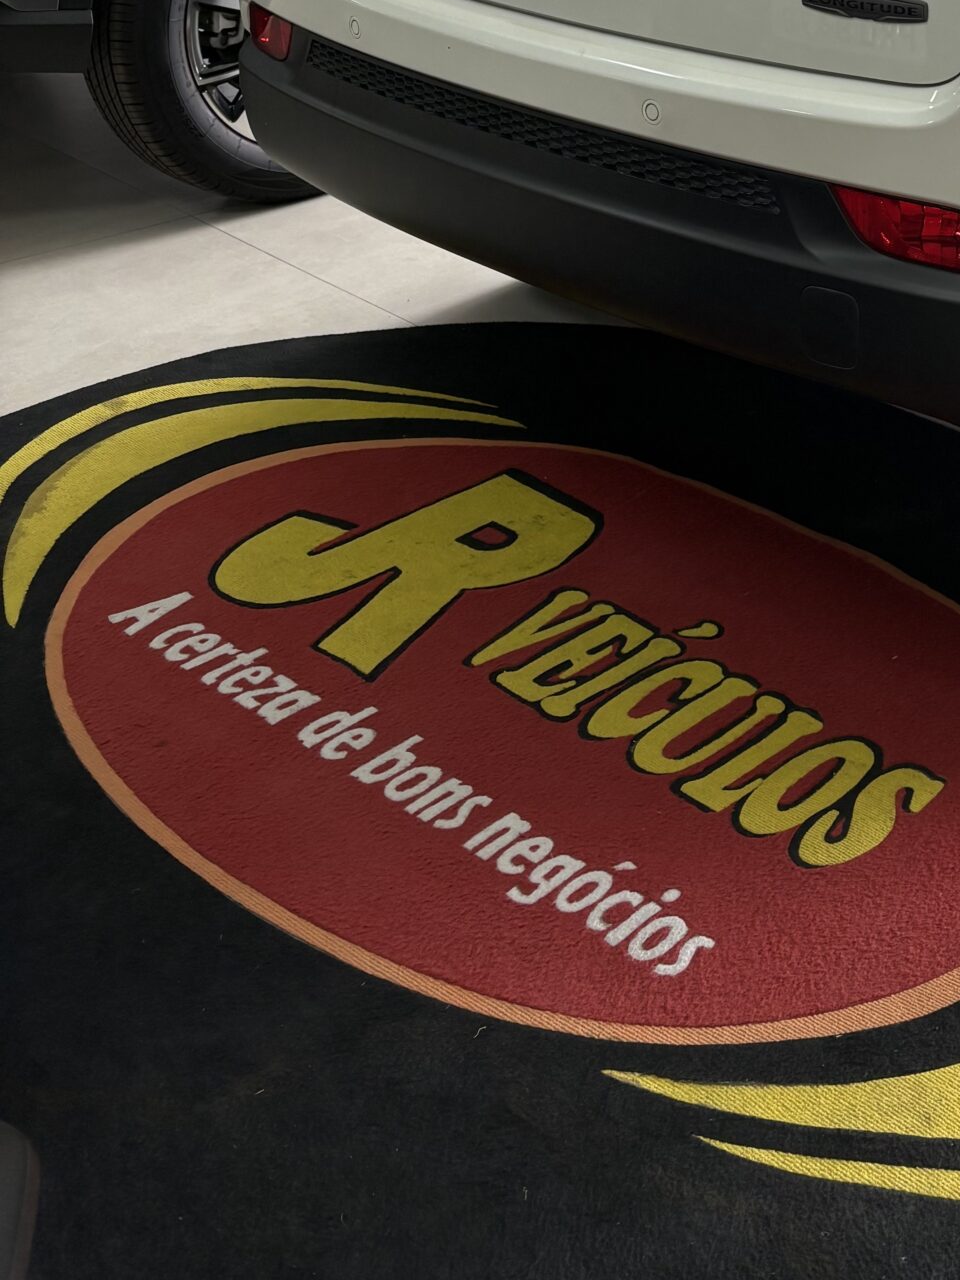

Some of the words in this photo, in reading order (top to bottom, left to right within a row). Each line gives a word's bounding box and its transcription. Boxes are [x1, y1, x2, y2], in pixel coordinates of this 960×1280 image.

[108, 591, 194, 636] A
[149, 622, 322, 726] certeza
[209, 470, 603, 682] JR
[463, 589, 946, 869] VEÍCULOS
[297, 703, 378, 760] de
[350, 734, 493, 829] bons
[462, 812, 715, 977] negócios
